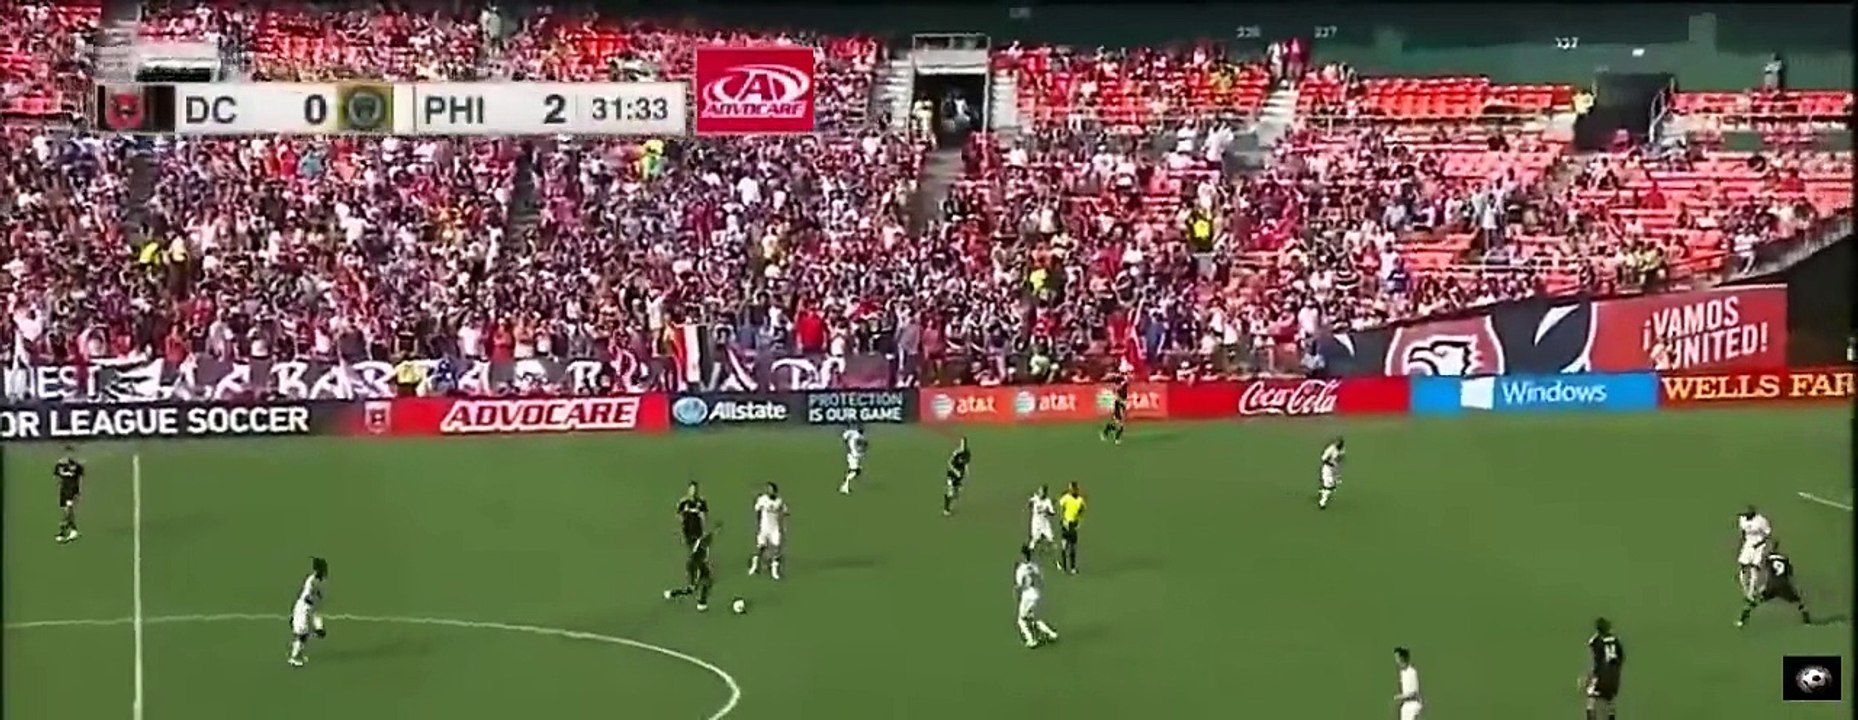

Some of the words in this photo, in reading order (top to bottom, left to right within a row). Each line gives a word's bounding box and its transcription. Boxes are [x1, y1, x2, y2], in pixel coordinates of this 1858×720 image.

[1501, 380, 1608, 405] Windows
[1660, 374, 1781, 400] WELLS
[708, 402, 787, 422] Allstate
[808, 393, 904, 408] PROTECTION
[50, 408, 179, 436] LEAGUE
[187, 405, 309, 434] SOCCER
[440, 397, 641, 432] ADVOCARE
[808, 408, 823, 422] IS
[825, 408, 857, 422] OUR
[860, 407, 904, 421] GAME
